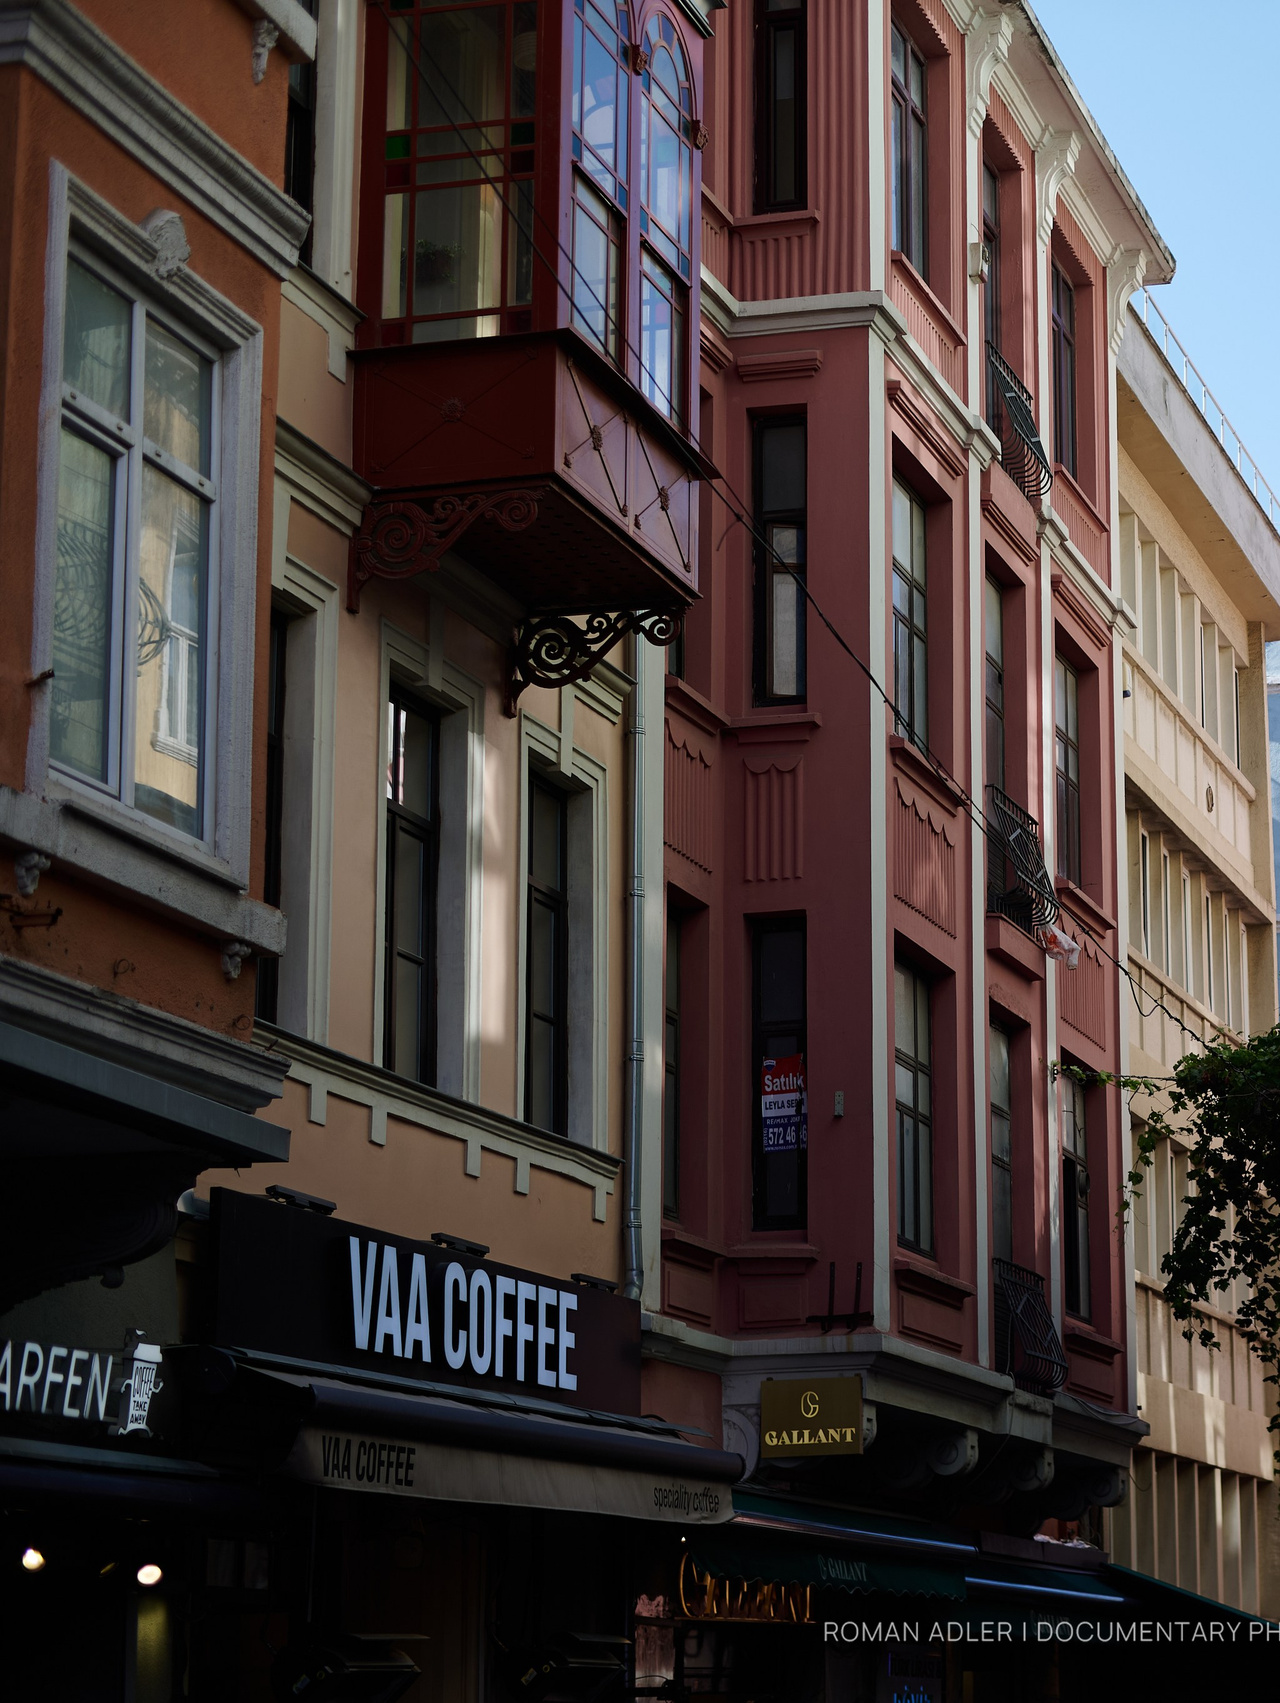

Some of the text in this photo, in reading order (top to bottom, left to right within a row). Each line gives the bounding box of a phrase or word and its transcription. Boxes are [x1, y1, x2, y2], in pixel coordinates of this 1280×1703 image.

[765, 1100, 785, 1111] LEYLA
[769, 1126, 784, 1146] 572
[786, 1125, 797, 1144] 46
[349, 1235, 578, 1392] VAA COFFEE
[133, 1366, 156, 1399] COFFEE
[133, 1400, 148, 1412] TAKE
[130, 1413, 147, 1425] AWAY
[764, 1427, 856, 1446] GALLANT
[322, 1435, 416, 1487] VAA COFFEE
[654, 1483, 720, 1516] speciality coffee
[827, 1558, 868, 1582] GALLANT
